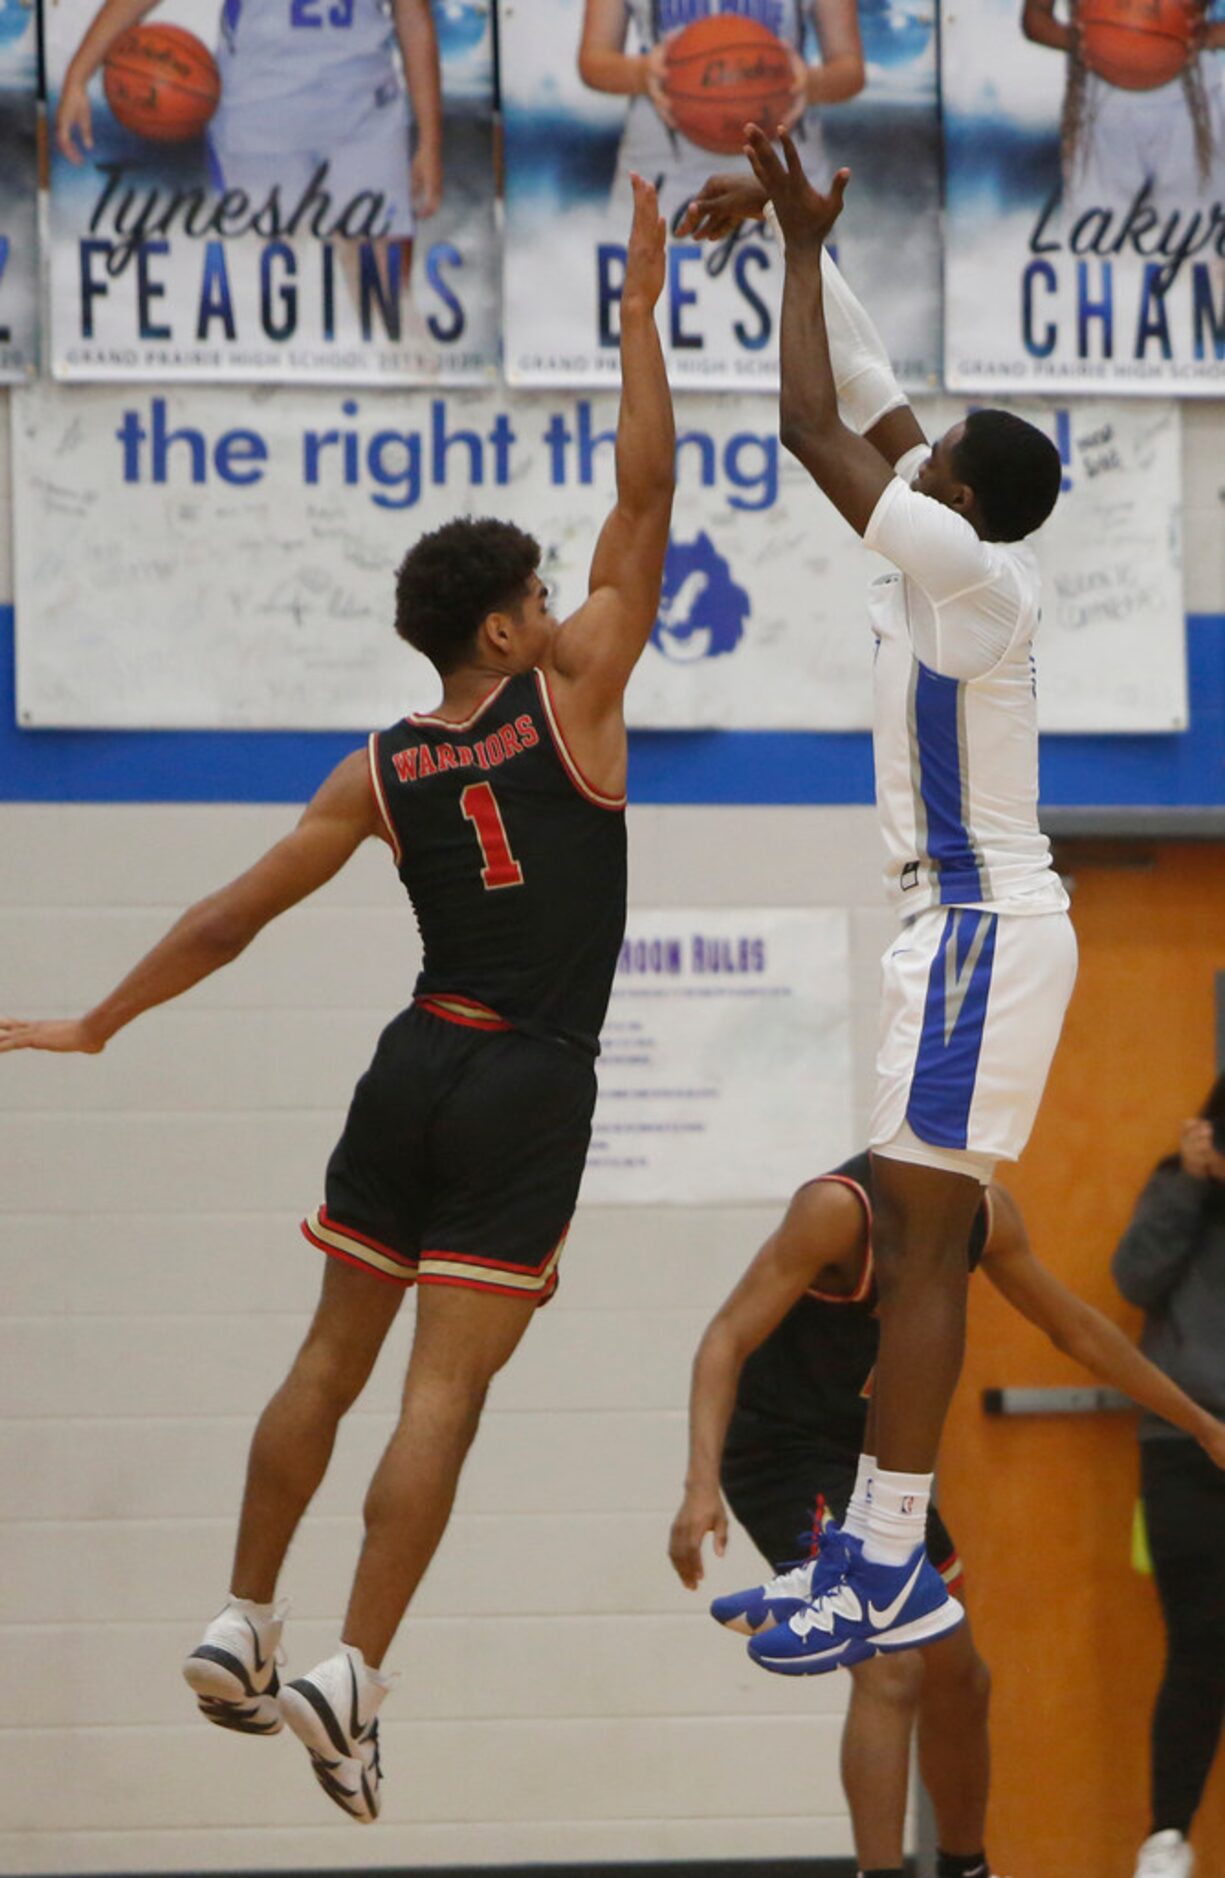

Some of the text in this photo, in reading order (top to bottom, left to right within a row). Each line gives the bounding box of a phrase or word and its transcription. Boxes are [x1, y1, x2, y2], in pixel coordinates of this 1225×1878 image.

[89, 157, 391, 278] Tynesha
[79, 239, 465, 343] FEAGINS
[597, 243, 839, 351] BES
[116, 397, 268, 485] the
[303, 399, 516, 510] right
[543, 400, 779, 511] thng
[392, 714, 540, 783] WARRIORS
[460, 781, 524, 891] 1
